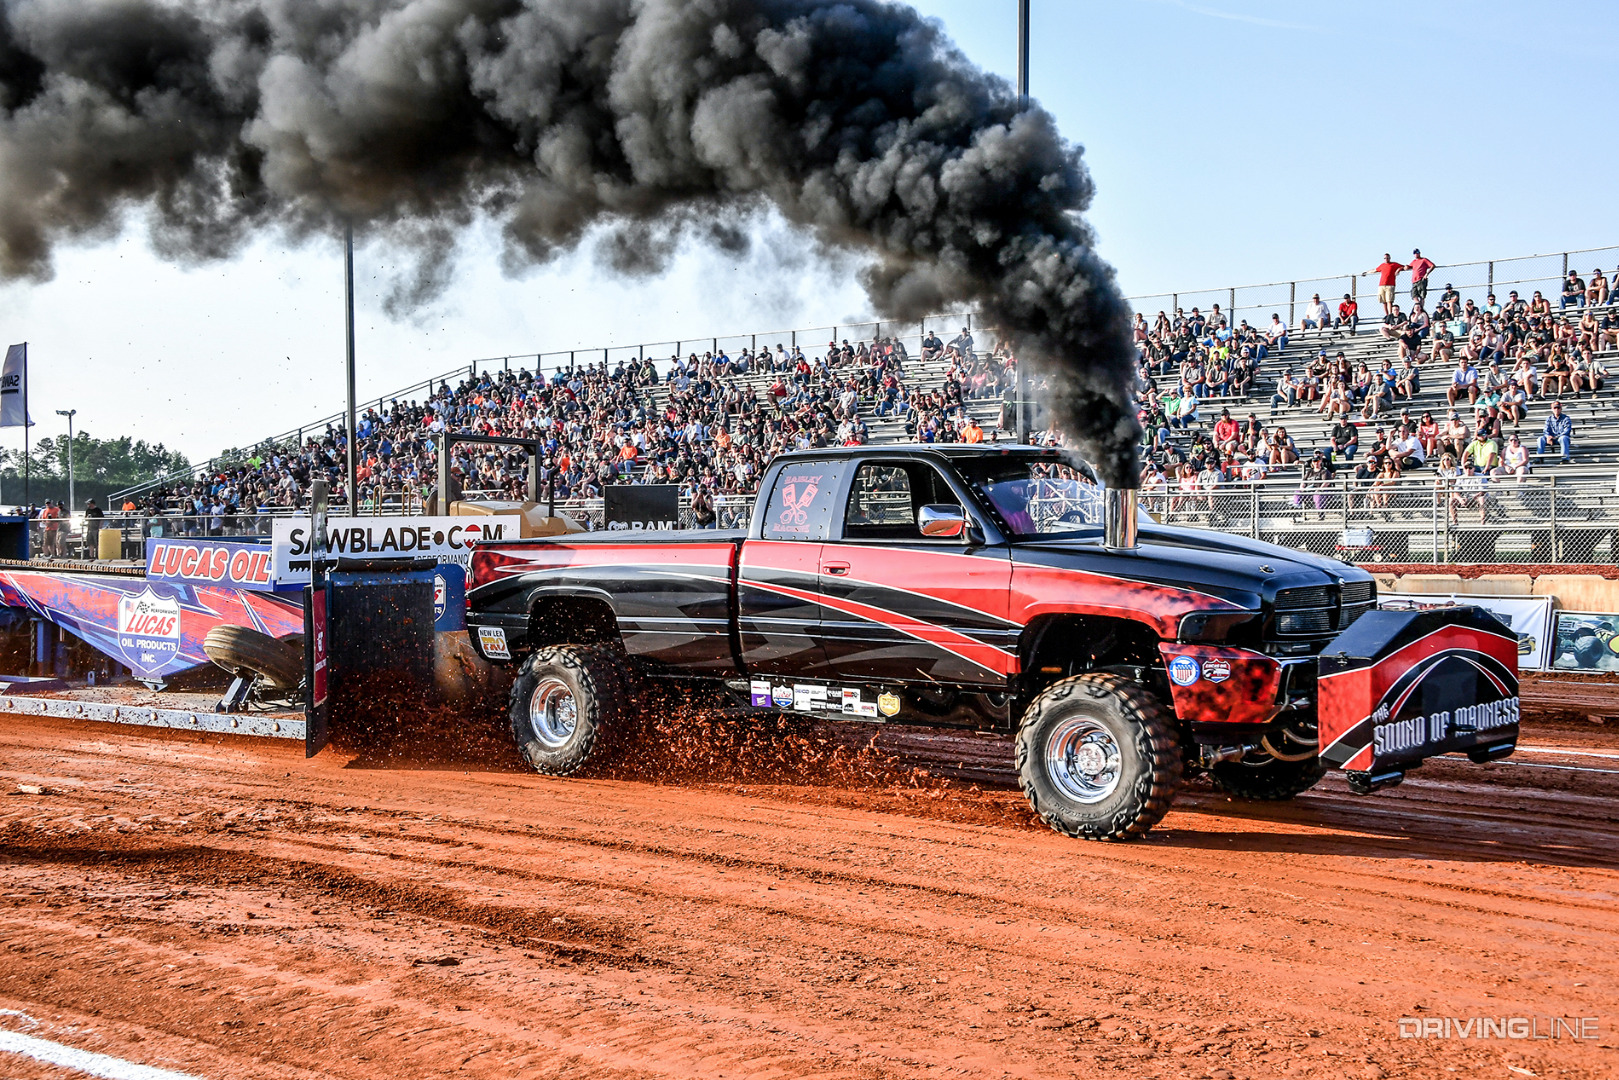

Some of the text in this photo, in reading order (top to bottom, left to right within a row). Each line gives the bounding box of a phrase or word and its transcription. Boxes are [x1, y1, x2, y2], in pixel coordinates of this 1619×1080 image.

[632, 520, 673, 531] RAM
[149, 545, 272, 584] LUCAS OIL
[125, 614, 176, 635] LUCAS
[121, 638, 176, 651] OIL PRODUCTS
[141, 653, 157, 663] INC.
[1372, 702, 1389, 723] THE
[1373, 696, 1520, 756] SOUND OF MADNESS
